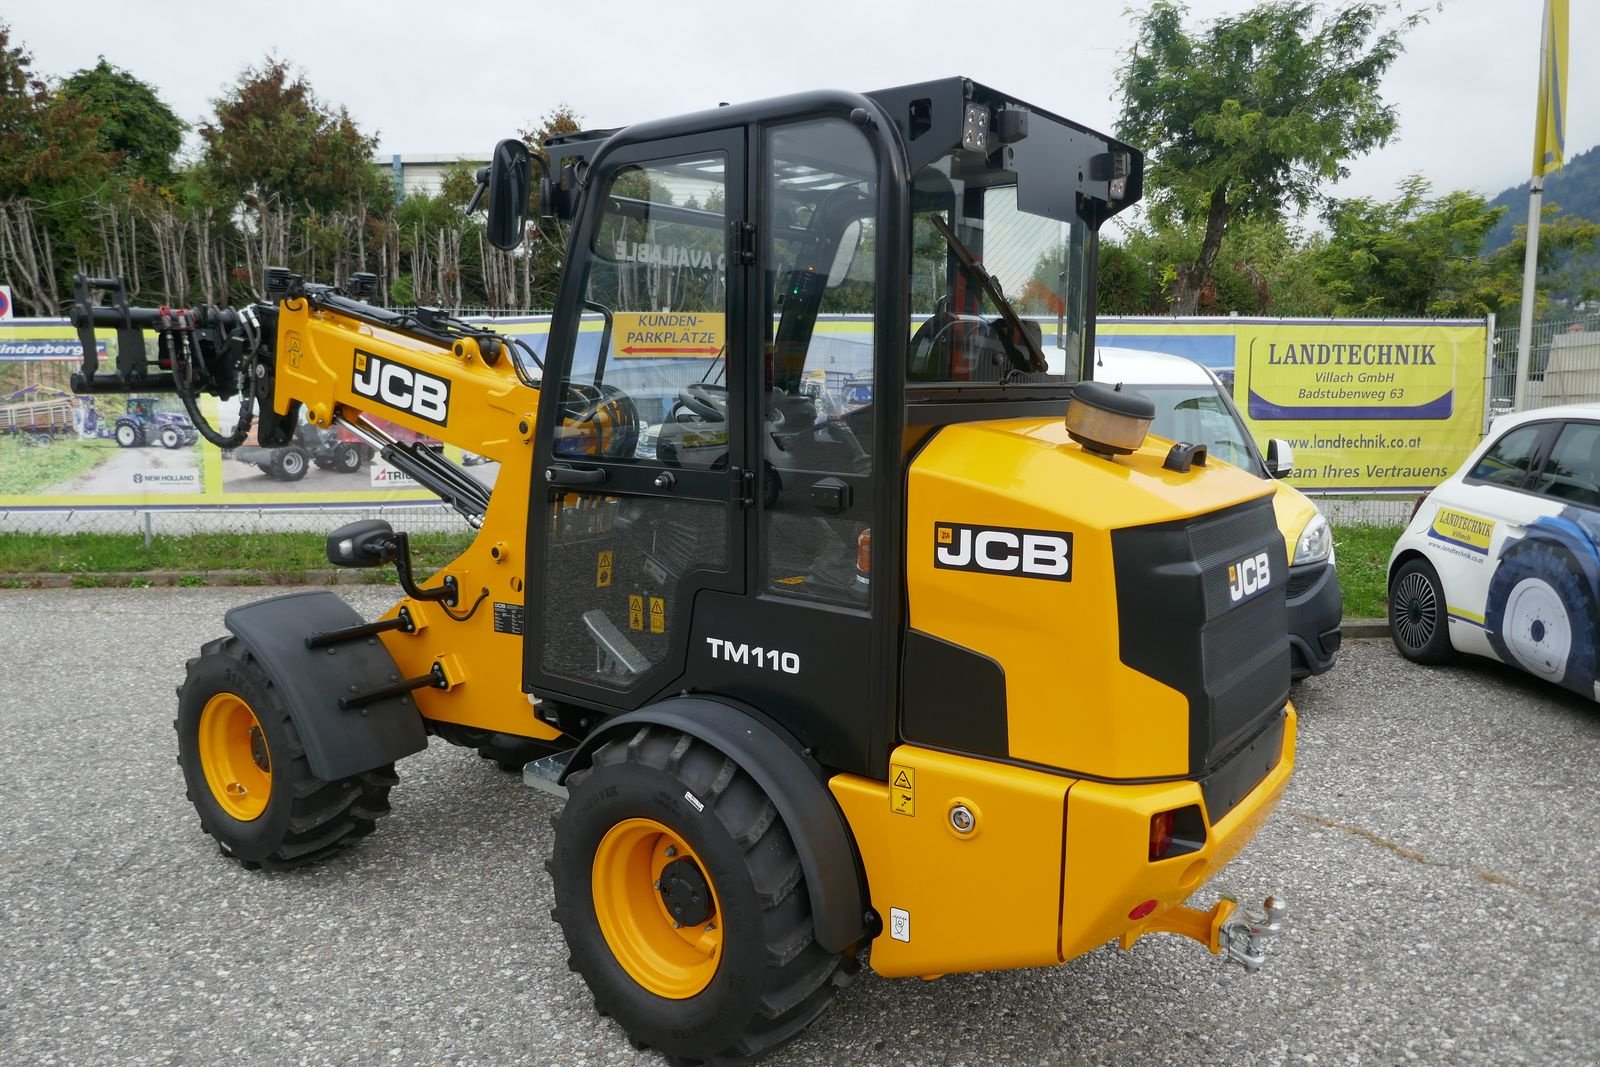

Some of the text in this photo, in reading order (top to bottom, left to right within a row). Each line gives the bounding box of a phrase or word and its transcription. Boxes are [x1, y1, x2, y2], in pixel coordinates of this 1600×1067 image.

[638, 315, 704, 327] KUNDEN-
[626, 328, 716, 344] PARKPLÄTZE
[0, 344, 105, 356] inderbergr
[1268, 343, 1436, 365] LANDTECHNIK
[1315, 372, 1395, 383] Villach GmbH
[354, 358, 447, 422] JCB
[1298, 389, 1405, 401] Badstubenweg 63
[1284, 434, 1422, 449] ww.landtechnik.co.at
[1322, 464, 1360, 478] Ihres
[1366, 464, 1448, 478] Vertrauens
[1440, 511, 1493, 537] LANDTECHNIK
[937, 529, 1069, 576] JCB
[1230, 552, 1271, 602] JCB
[706, 637, 800, 674] TM110
